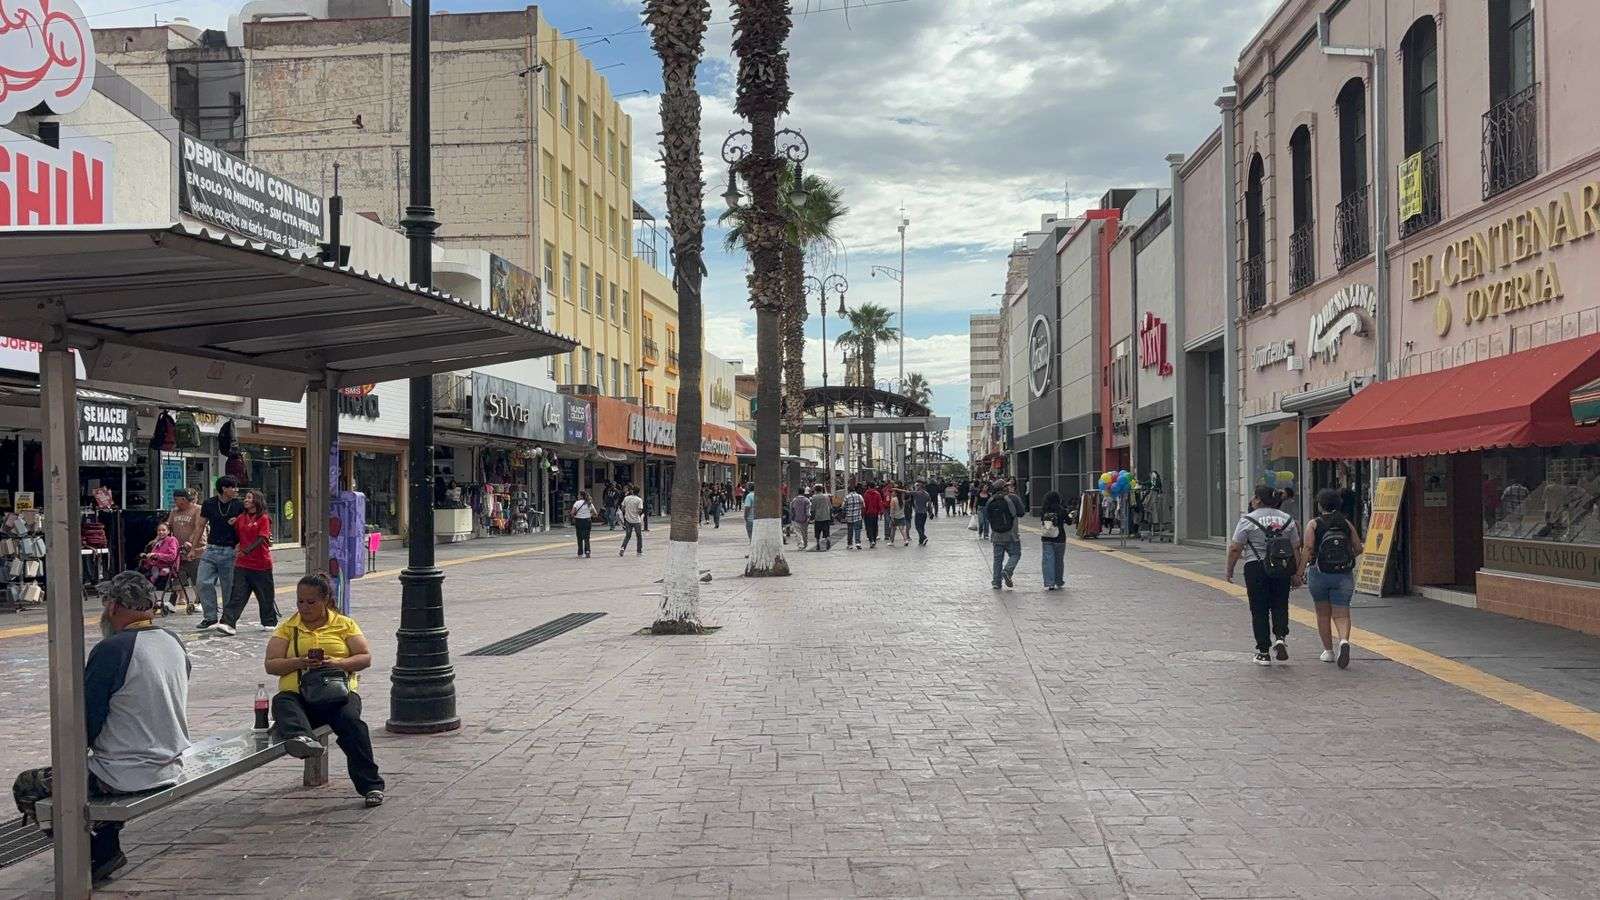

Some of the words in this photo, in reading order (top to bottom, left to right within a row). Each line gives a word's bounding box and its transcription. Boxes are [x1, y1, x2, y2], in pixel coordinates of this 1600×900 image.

[186, 171, 200, 187] EN
[200, 176, 223, 196] SOLO
[224, 186, 233, 200] 10
[233, 190, 265, 214] MINUTOS
[269, 206, 282, 221] SIN
[282, 212, 298, 227] CITA
[267, 177, 294, 206] CON
[295, 191, 320, 217] HILO
[264, 225, 282, 243] forma
[282, 234, 288, 243] a
[1409, 255, 1440, 301] EL
[1463, 262, 1564, 326] JOYERIA
[344, 386, 361, 395] SMS
[84, 406, 96, 422] SE
[97, 406, 127, 425] HACEN
[489, 392, 529, 423] Silvia
[88, 426, 123, 443] PLACAS
[82, 445, 129, 462] MILITARES
[1486, 543, 1499, 561] EL
[1502, 545, 1586, 570] CENTENARIO
